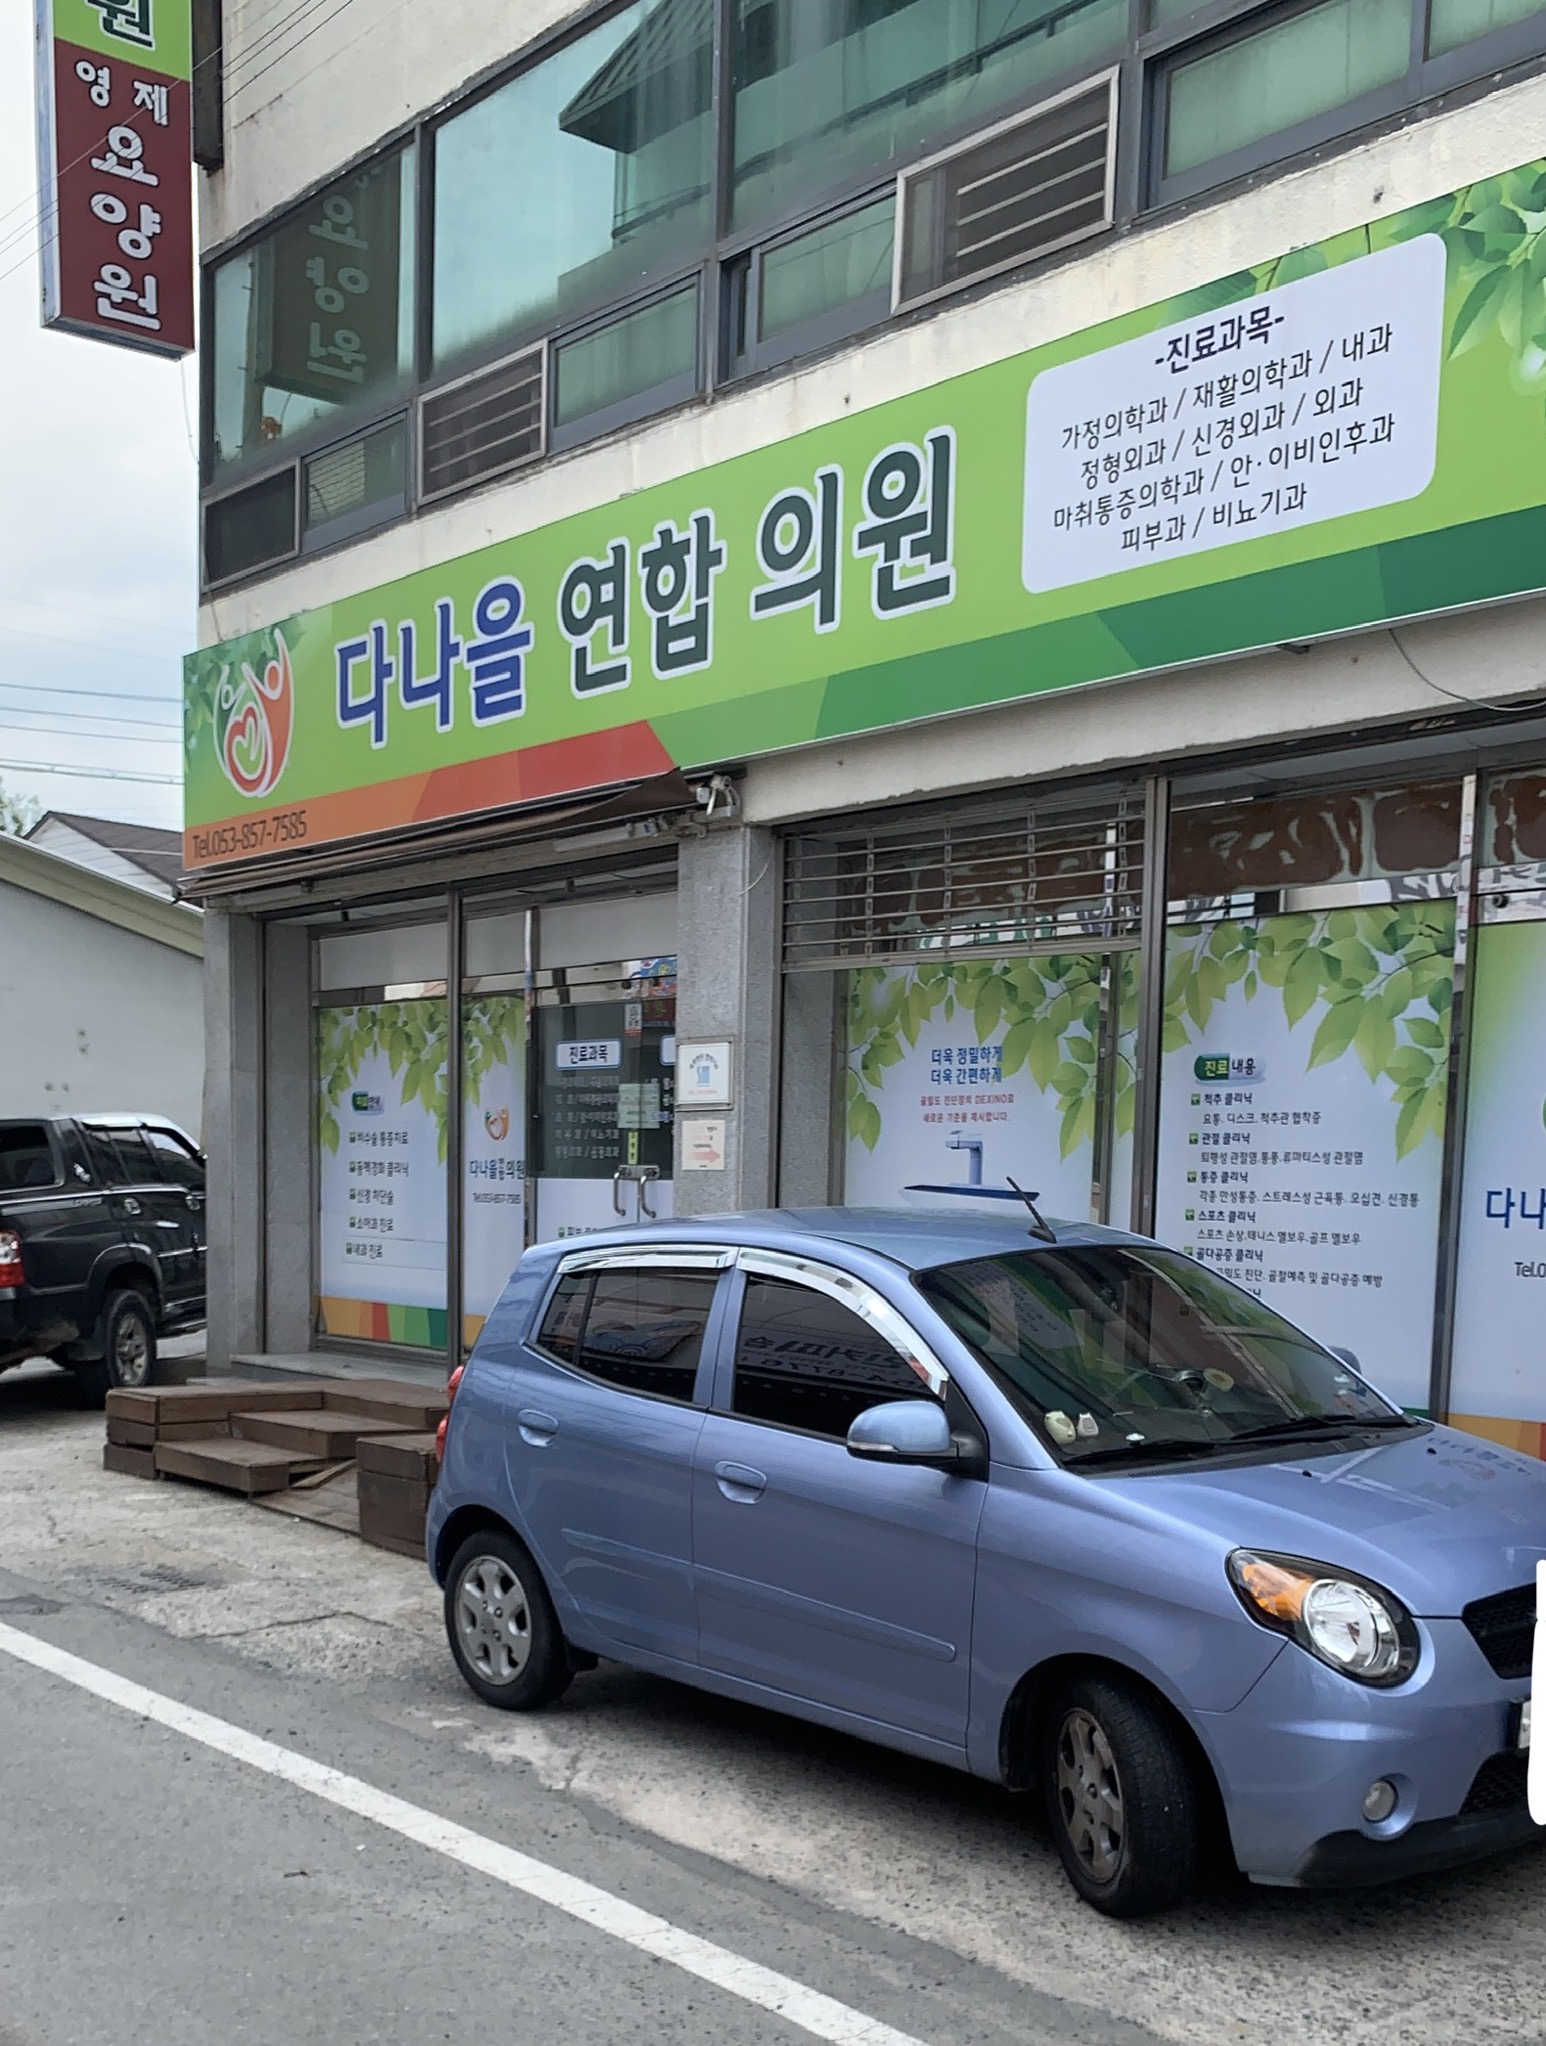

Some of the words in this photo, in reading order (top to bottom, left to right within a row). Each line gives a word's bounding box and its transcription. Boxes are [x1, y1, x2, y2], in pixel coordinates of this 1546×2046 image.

[90, 125, 162, 330] 요양원
[1062, 397, 1168, 450] 가정의학과
[1193, 349, 1312, 408] 재활의학과
[1342, 323, 1393, 361] 내과
[1081, 438, 1166, 490] 정형외과
[1192, 401, 1285, 457] 신경외과
[1313, 377, 1363, 416] 외과
[1054, 467, 1204, 531] 마취통증의학과
[1121, 514, 1186, 551] 피부과
[1213, 482, 1307, 527] 비뇨기과
[336, 575, 534, 749] 다나을
[558, 509, 727, 699] 연합
[749, 426, 957, 633] 의원
[931, 1048, 953, 1065] 더욱
[956, 1046, 1003, 1065] 정밀하게
[931, 1068, 952, 1085] 더욱
[956, 1067, 1002, 1085] 간편하게
[1204, 1093, 1222, 1106] 척추
[1225, 1092, 1252, 1106] 클리닉
[1202, 1132, 1220, 1145] 관절
[1222, 1132, 1250, 1145] 클리닉
[1200, 1171, 1218, 1184] 통증
[1221, 1171, 1248, 1184] 클리닉
[1198, 1210, 1225, 1221] 스포츠
[1228, 1210, 1256, 1223] 클리닉
[1197, 1229, 1224, 1240] 스포츠
[1235, 1249, 1264, 1262] 클리닉
